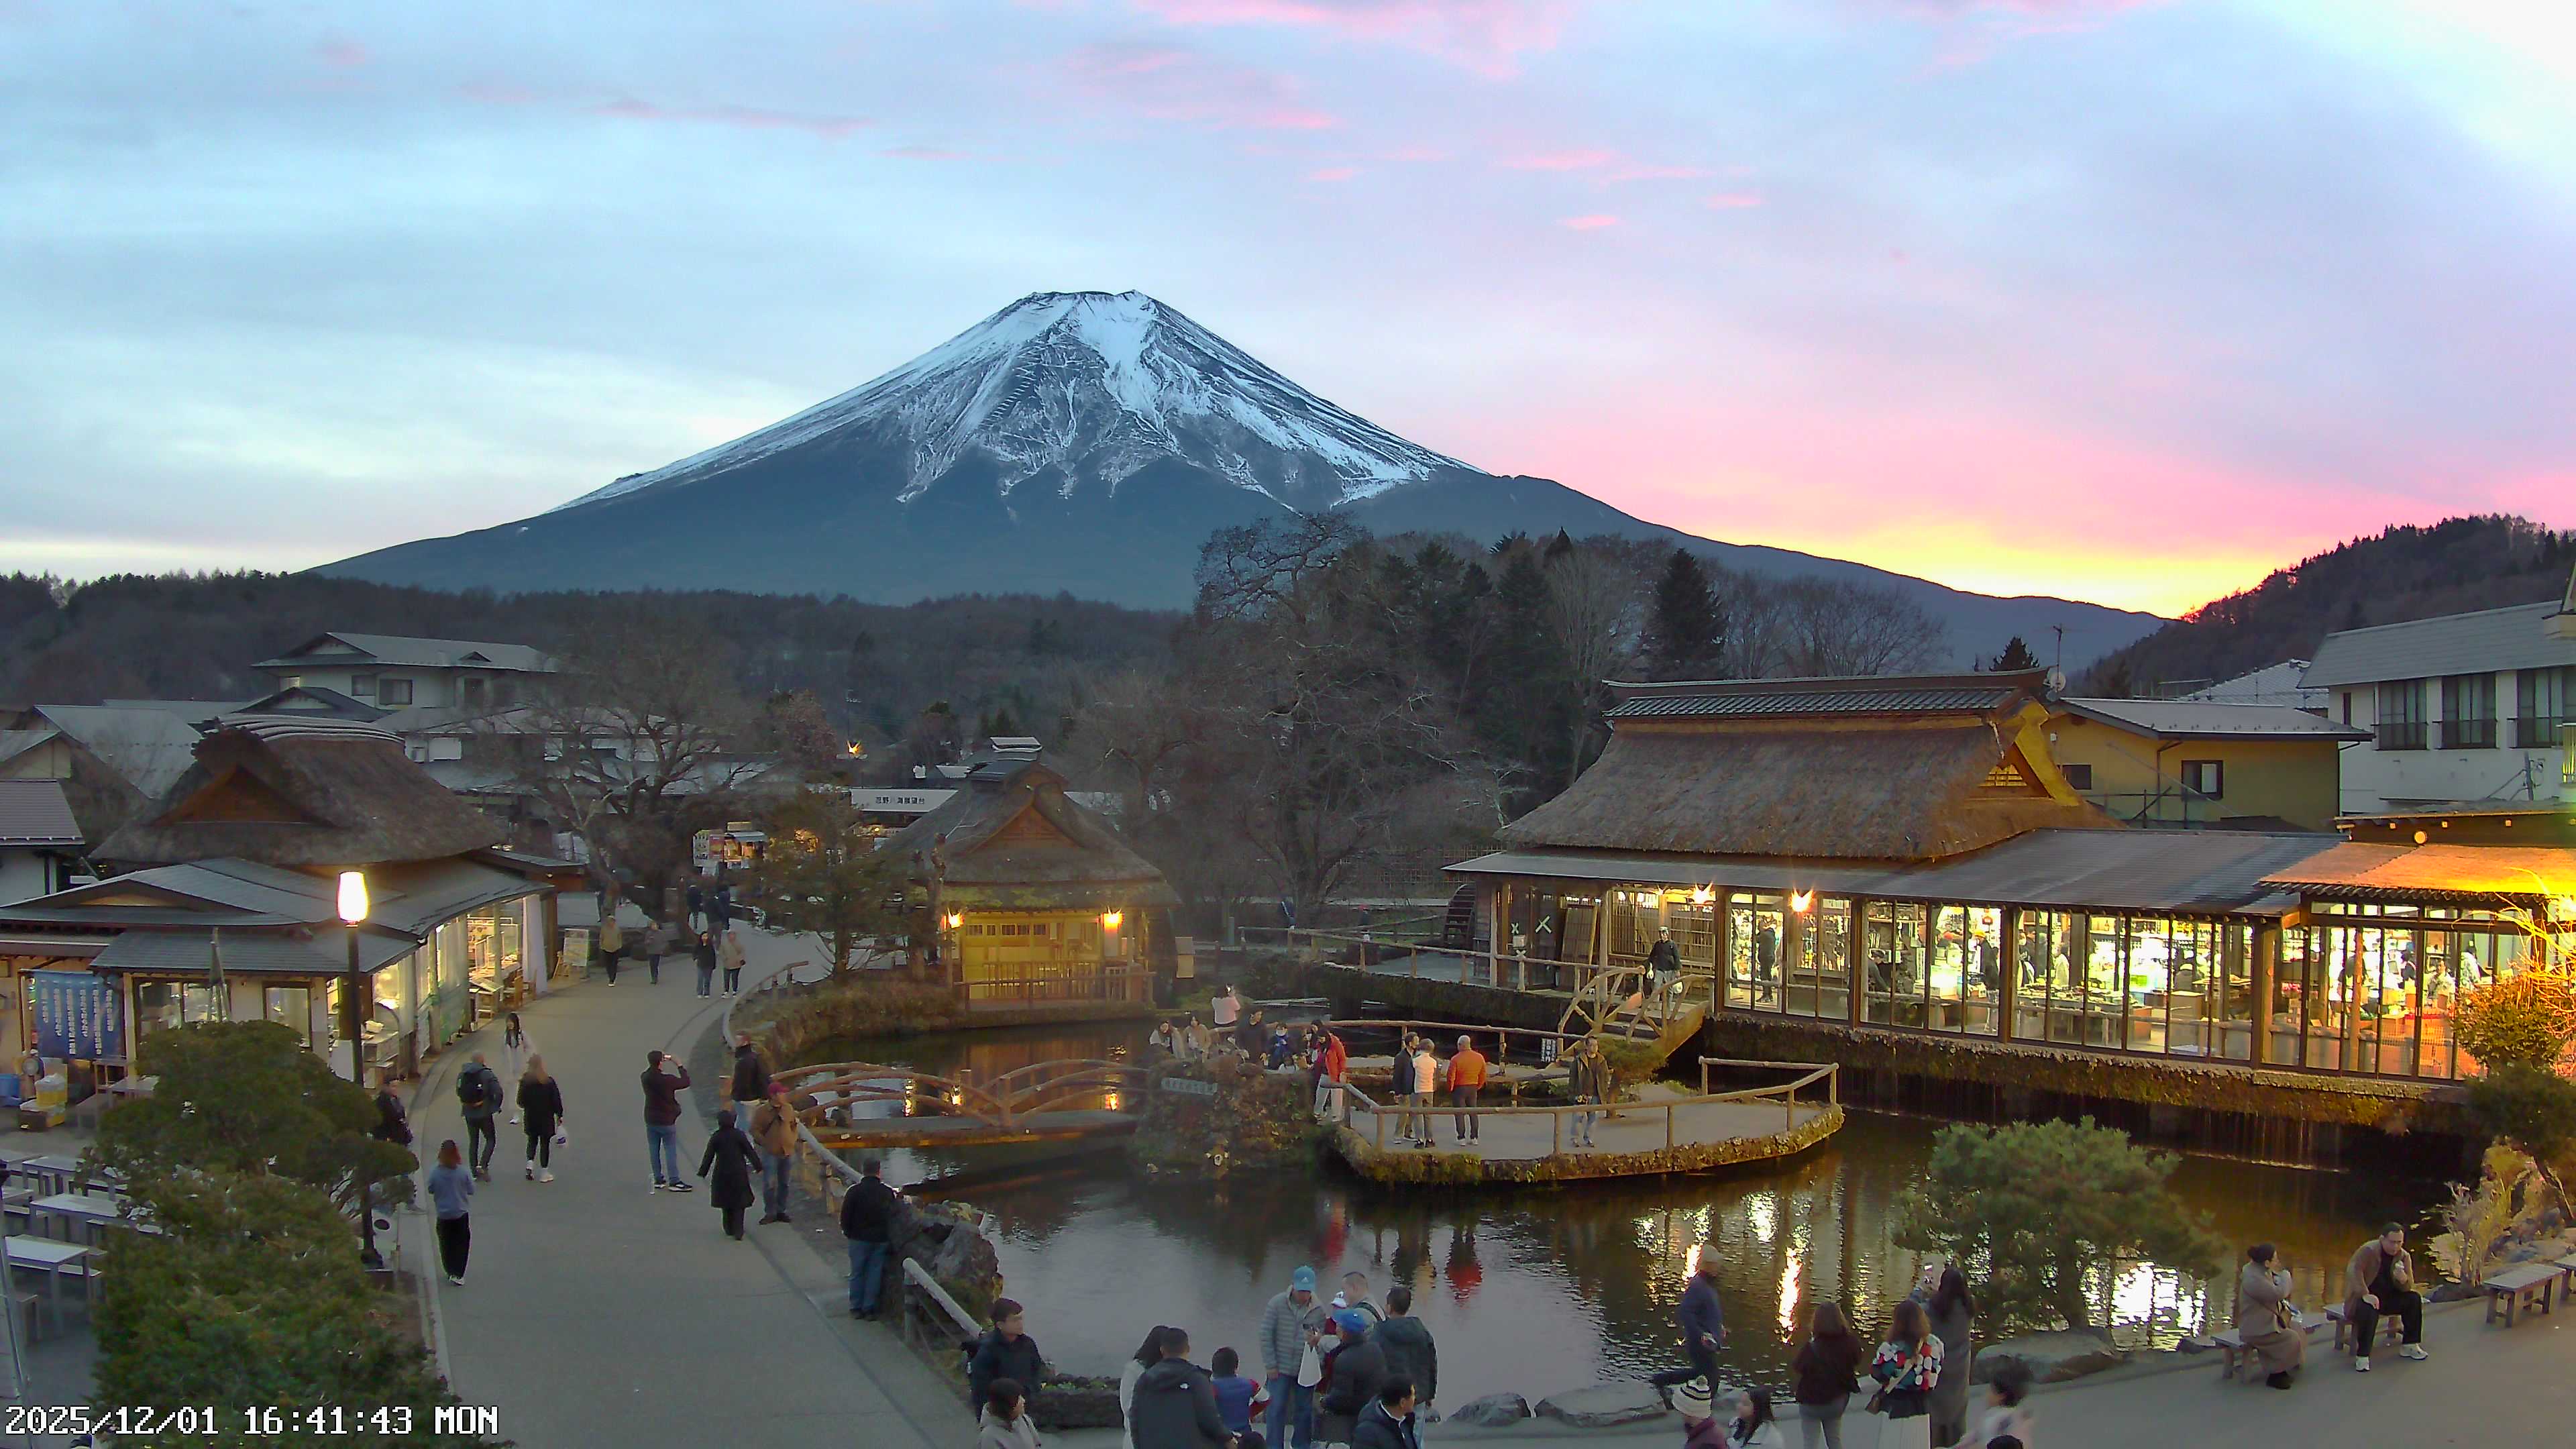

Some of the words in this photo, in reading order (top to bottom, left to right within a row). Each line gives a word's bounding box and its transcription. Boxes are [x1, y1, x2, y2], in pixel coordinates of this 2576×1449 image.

[875, 796, 924, 804] 忍野海展望台
